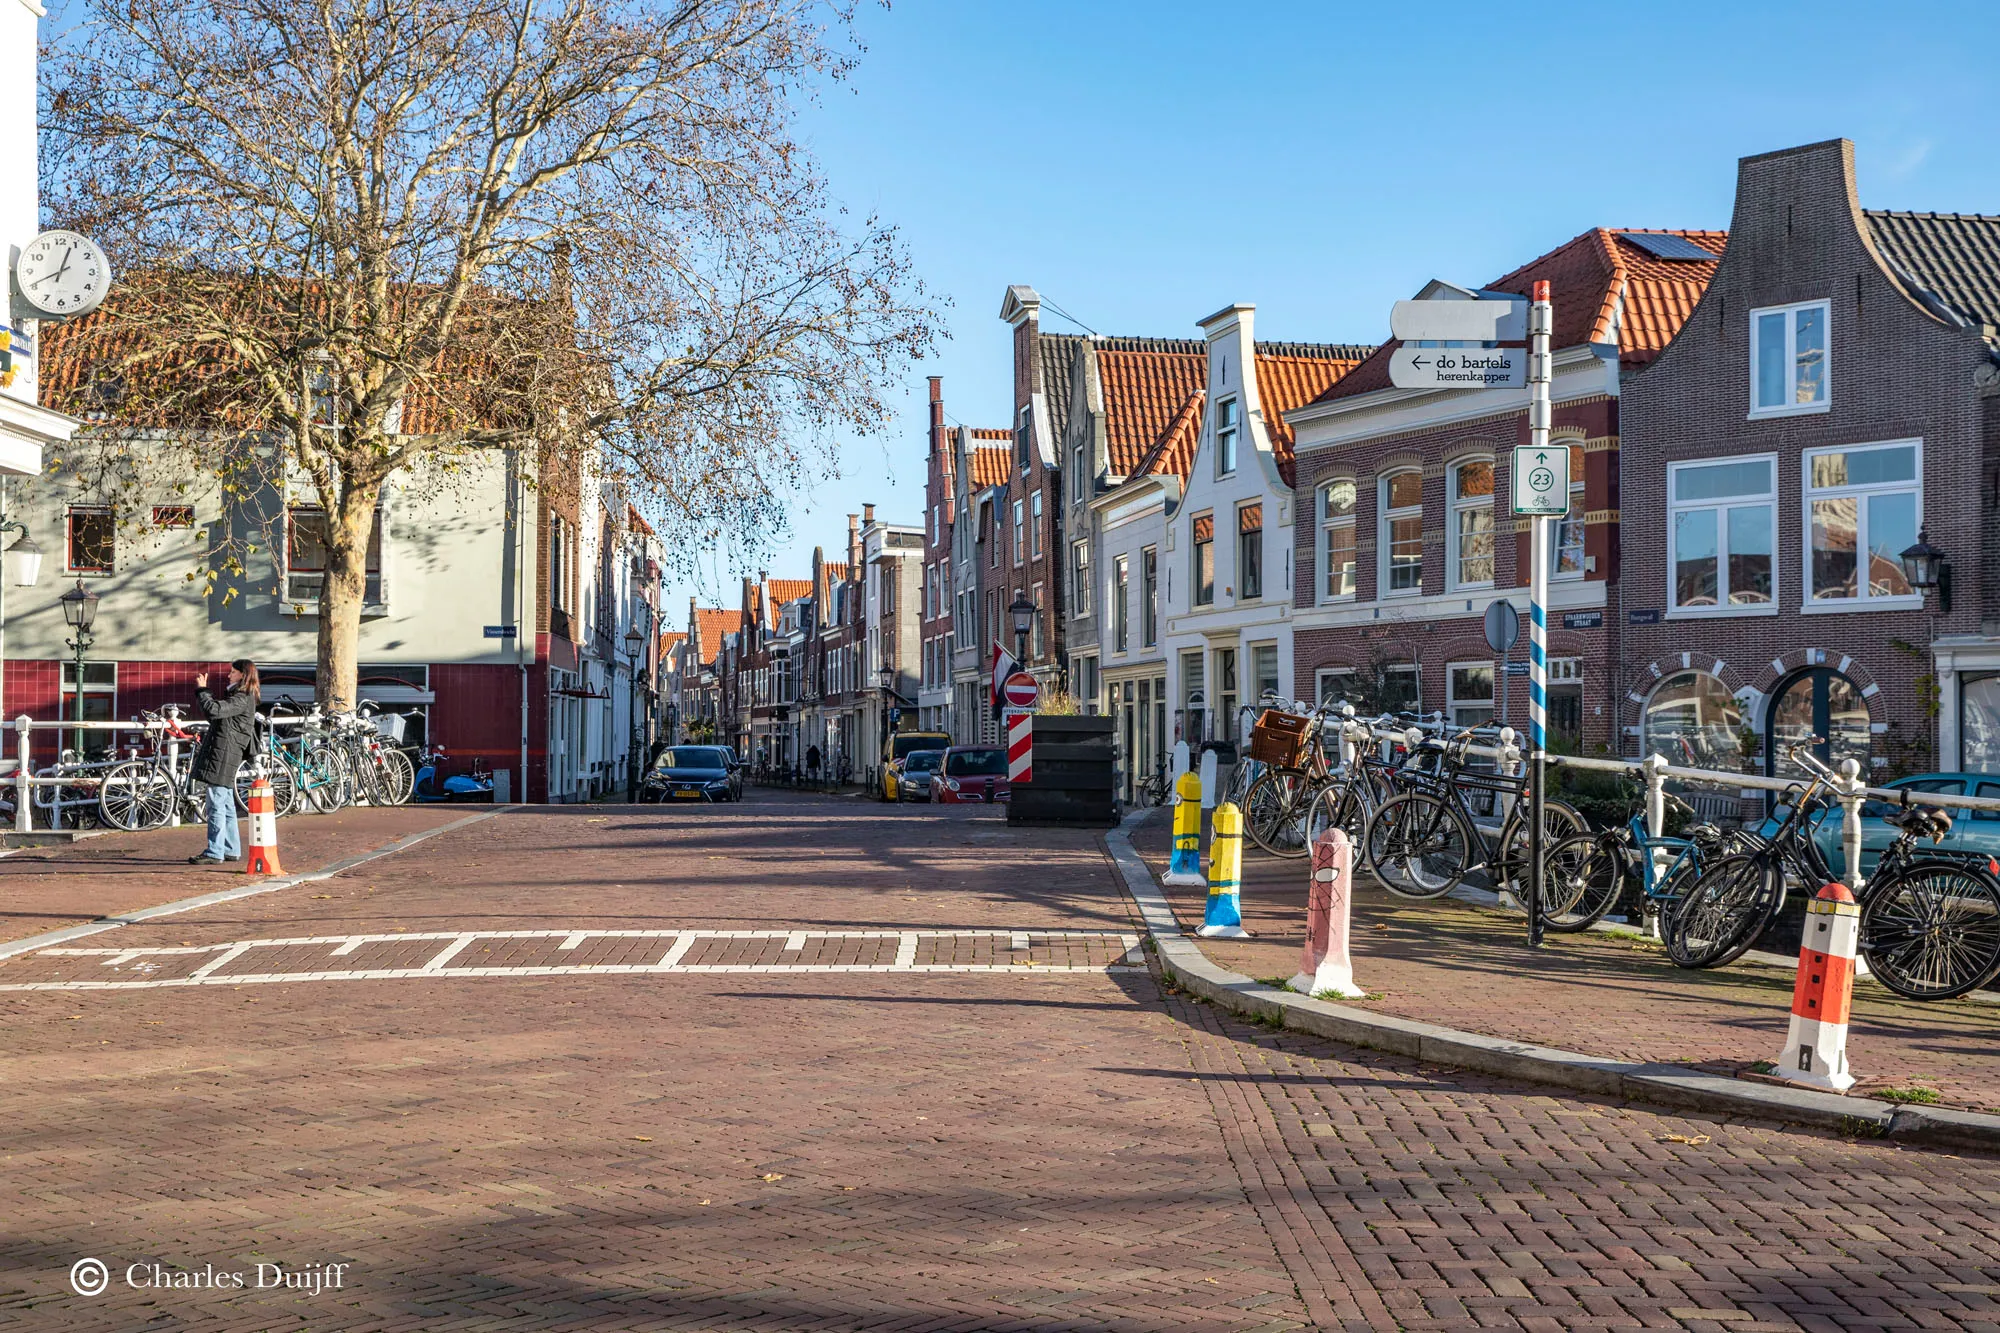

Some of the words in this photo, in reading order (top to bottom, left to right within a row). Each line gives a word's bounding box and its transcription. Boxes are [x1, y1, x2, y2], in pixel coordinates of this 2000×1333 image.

[73, 241, 78, 249] 1
[83, 252, 91, 260] 2
[88, 268, 96, 276] 3
[83, 283, 92, 291] 4
[57, 298, 65, 306] 6
[73, 294, 81, 302] 5
[1436, 354, 1456, 369] do
[1461, 354, 1511, 369] bartels
[1436, 370, 1511, 384] herenkapper
[1533, 474, 1550, 485] 23
[893, 708, 900, 718] P
